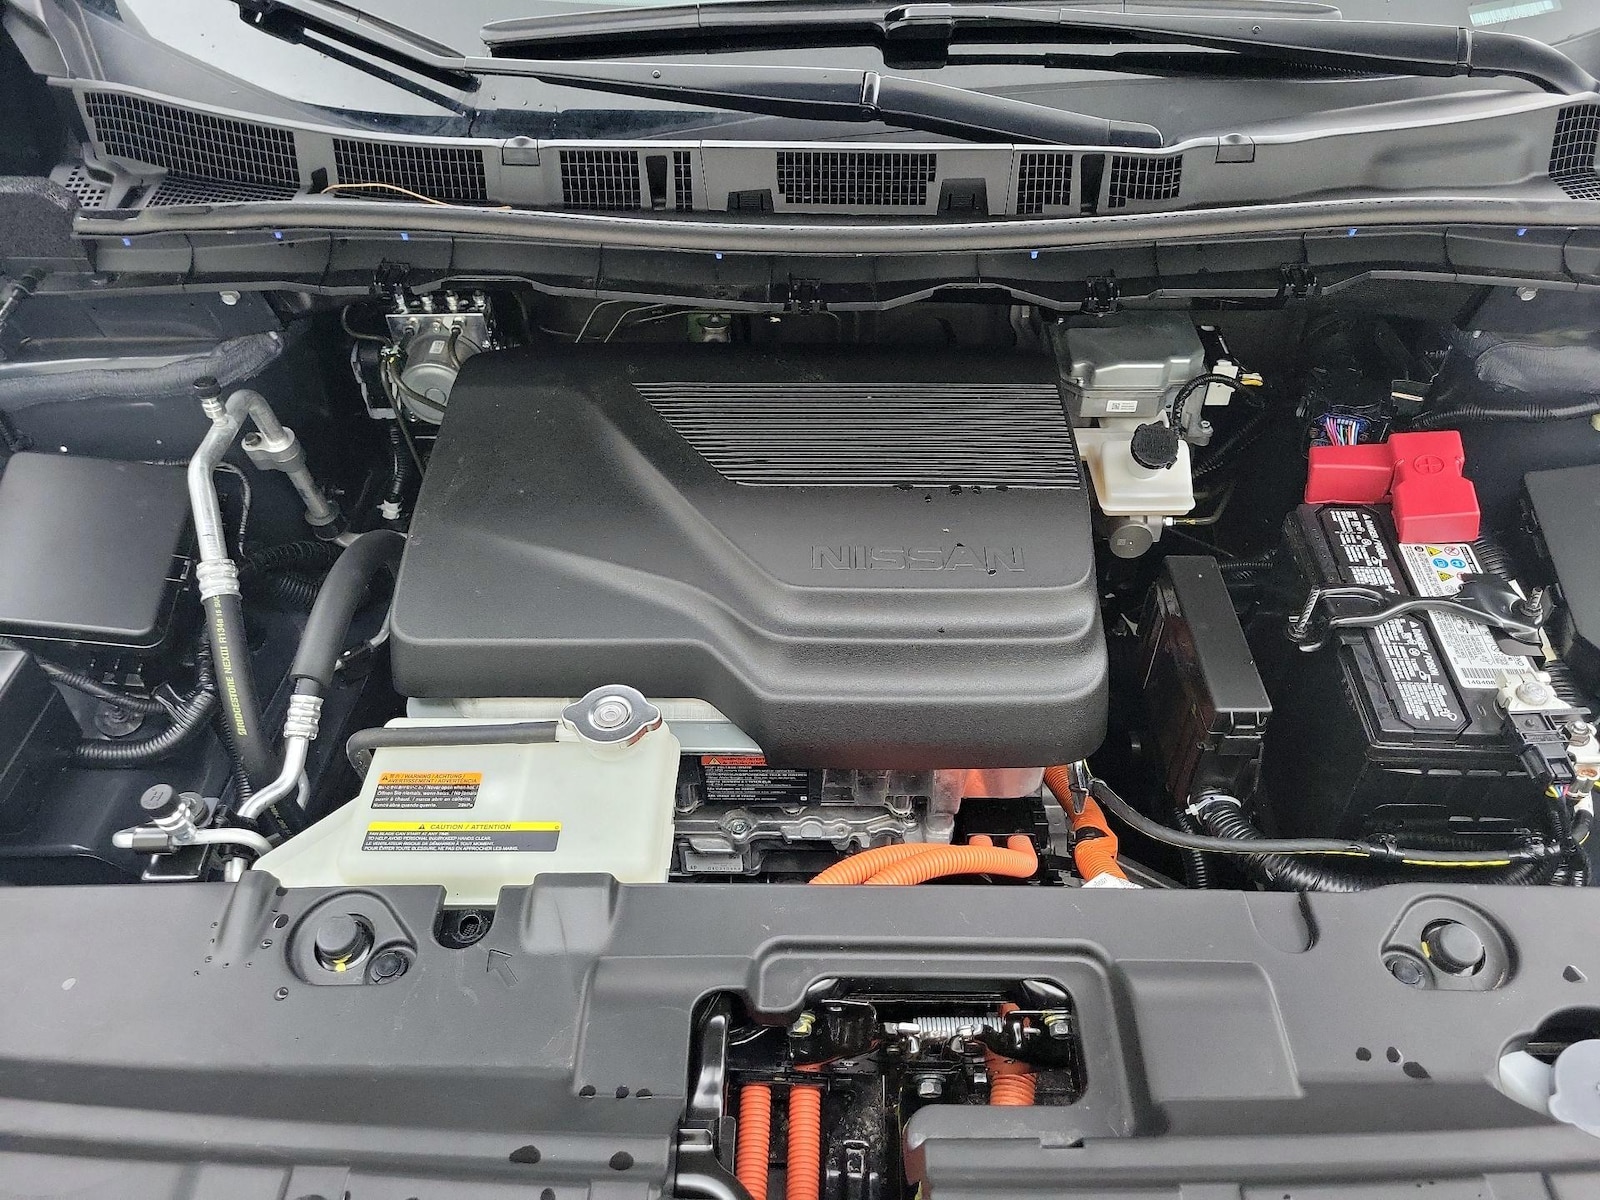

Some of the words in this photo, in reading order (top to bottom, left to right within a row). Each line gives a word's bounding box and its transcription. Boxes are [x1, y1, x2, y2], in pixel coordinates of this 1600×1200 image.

[811, 544, 1025, 571] NISSAN
[216, 618, 227, 644] R134a
[225, 676, 248, 736] BRIDGESTONE
